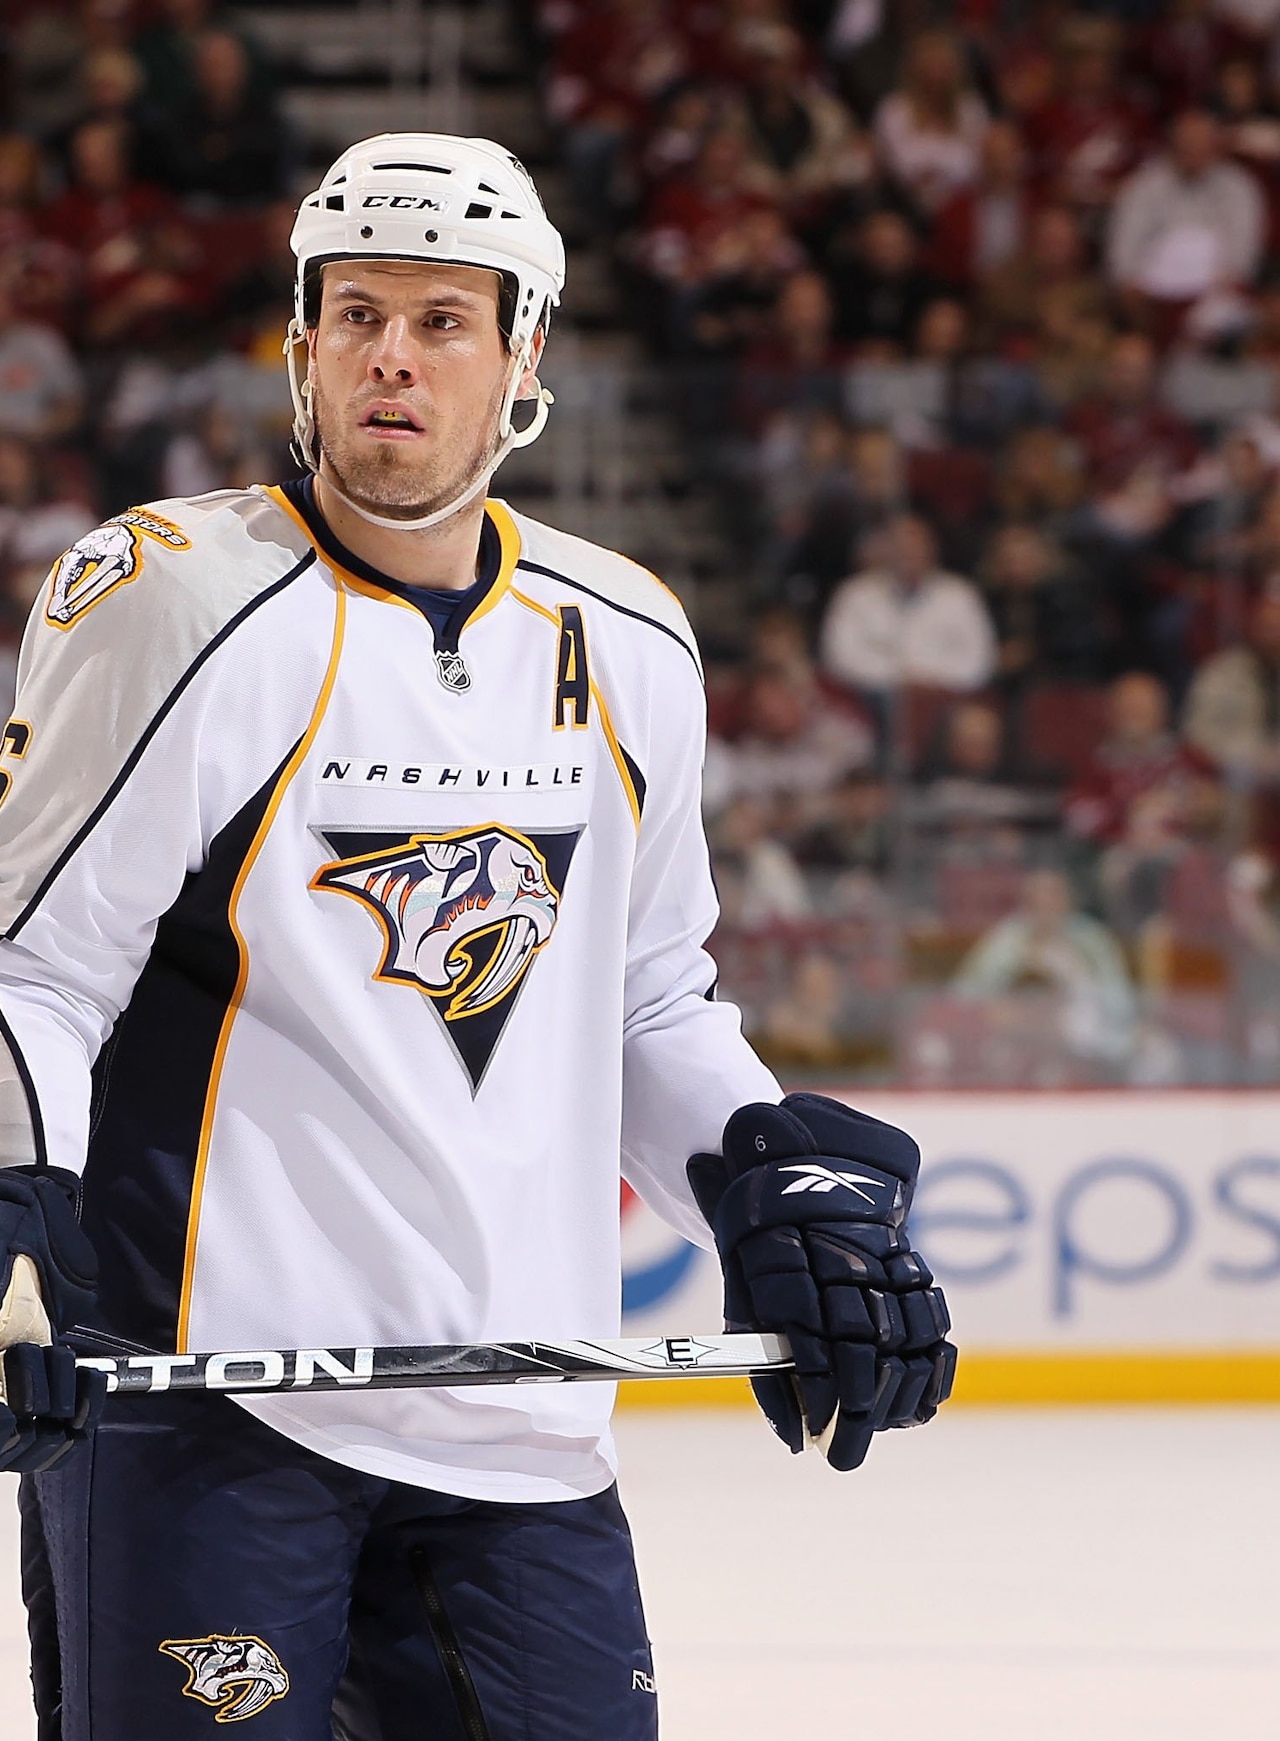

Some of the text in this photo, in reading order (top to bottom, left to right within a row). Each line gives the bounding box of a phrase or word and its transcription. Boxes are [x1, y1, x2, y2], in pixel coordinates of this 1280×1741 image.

[362, 196, 445, 212] CCM
[553, 603, 590, 731] A
[322, 762, 583, 787] NASHVILLE
[754, 1134, 767, 1152] 6
[908, 1156, 1280, 1320] eps
[665, 1338, 694, 1362] E
[631, 1669, 656, 1693] Rb
